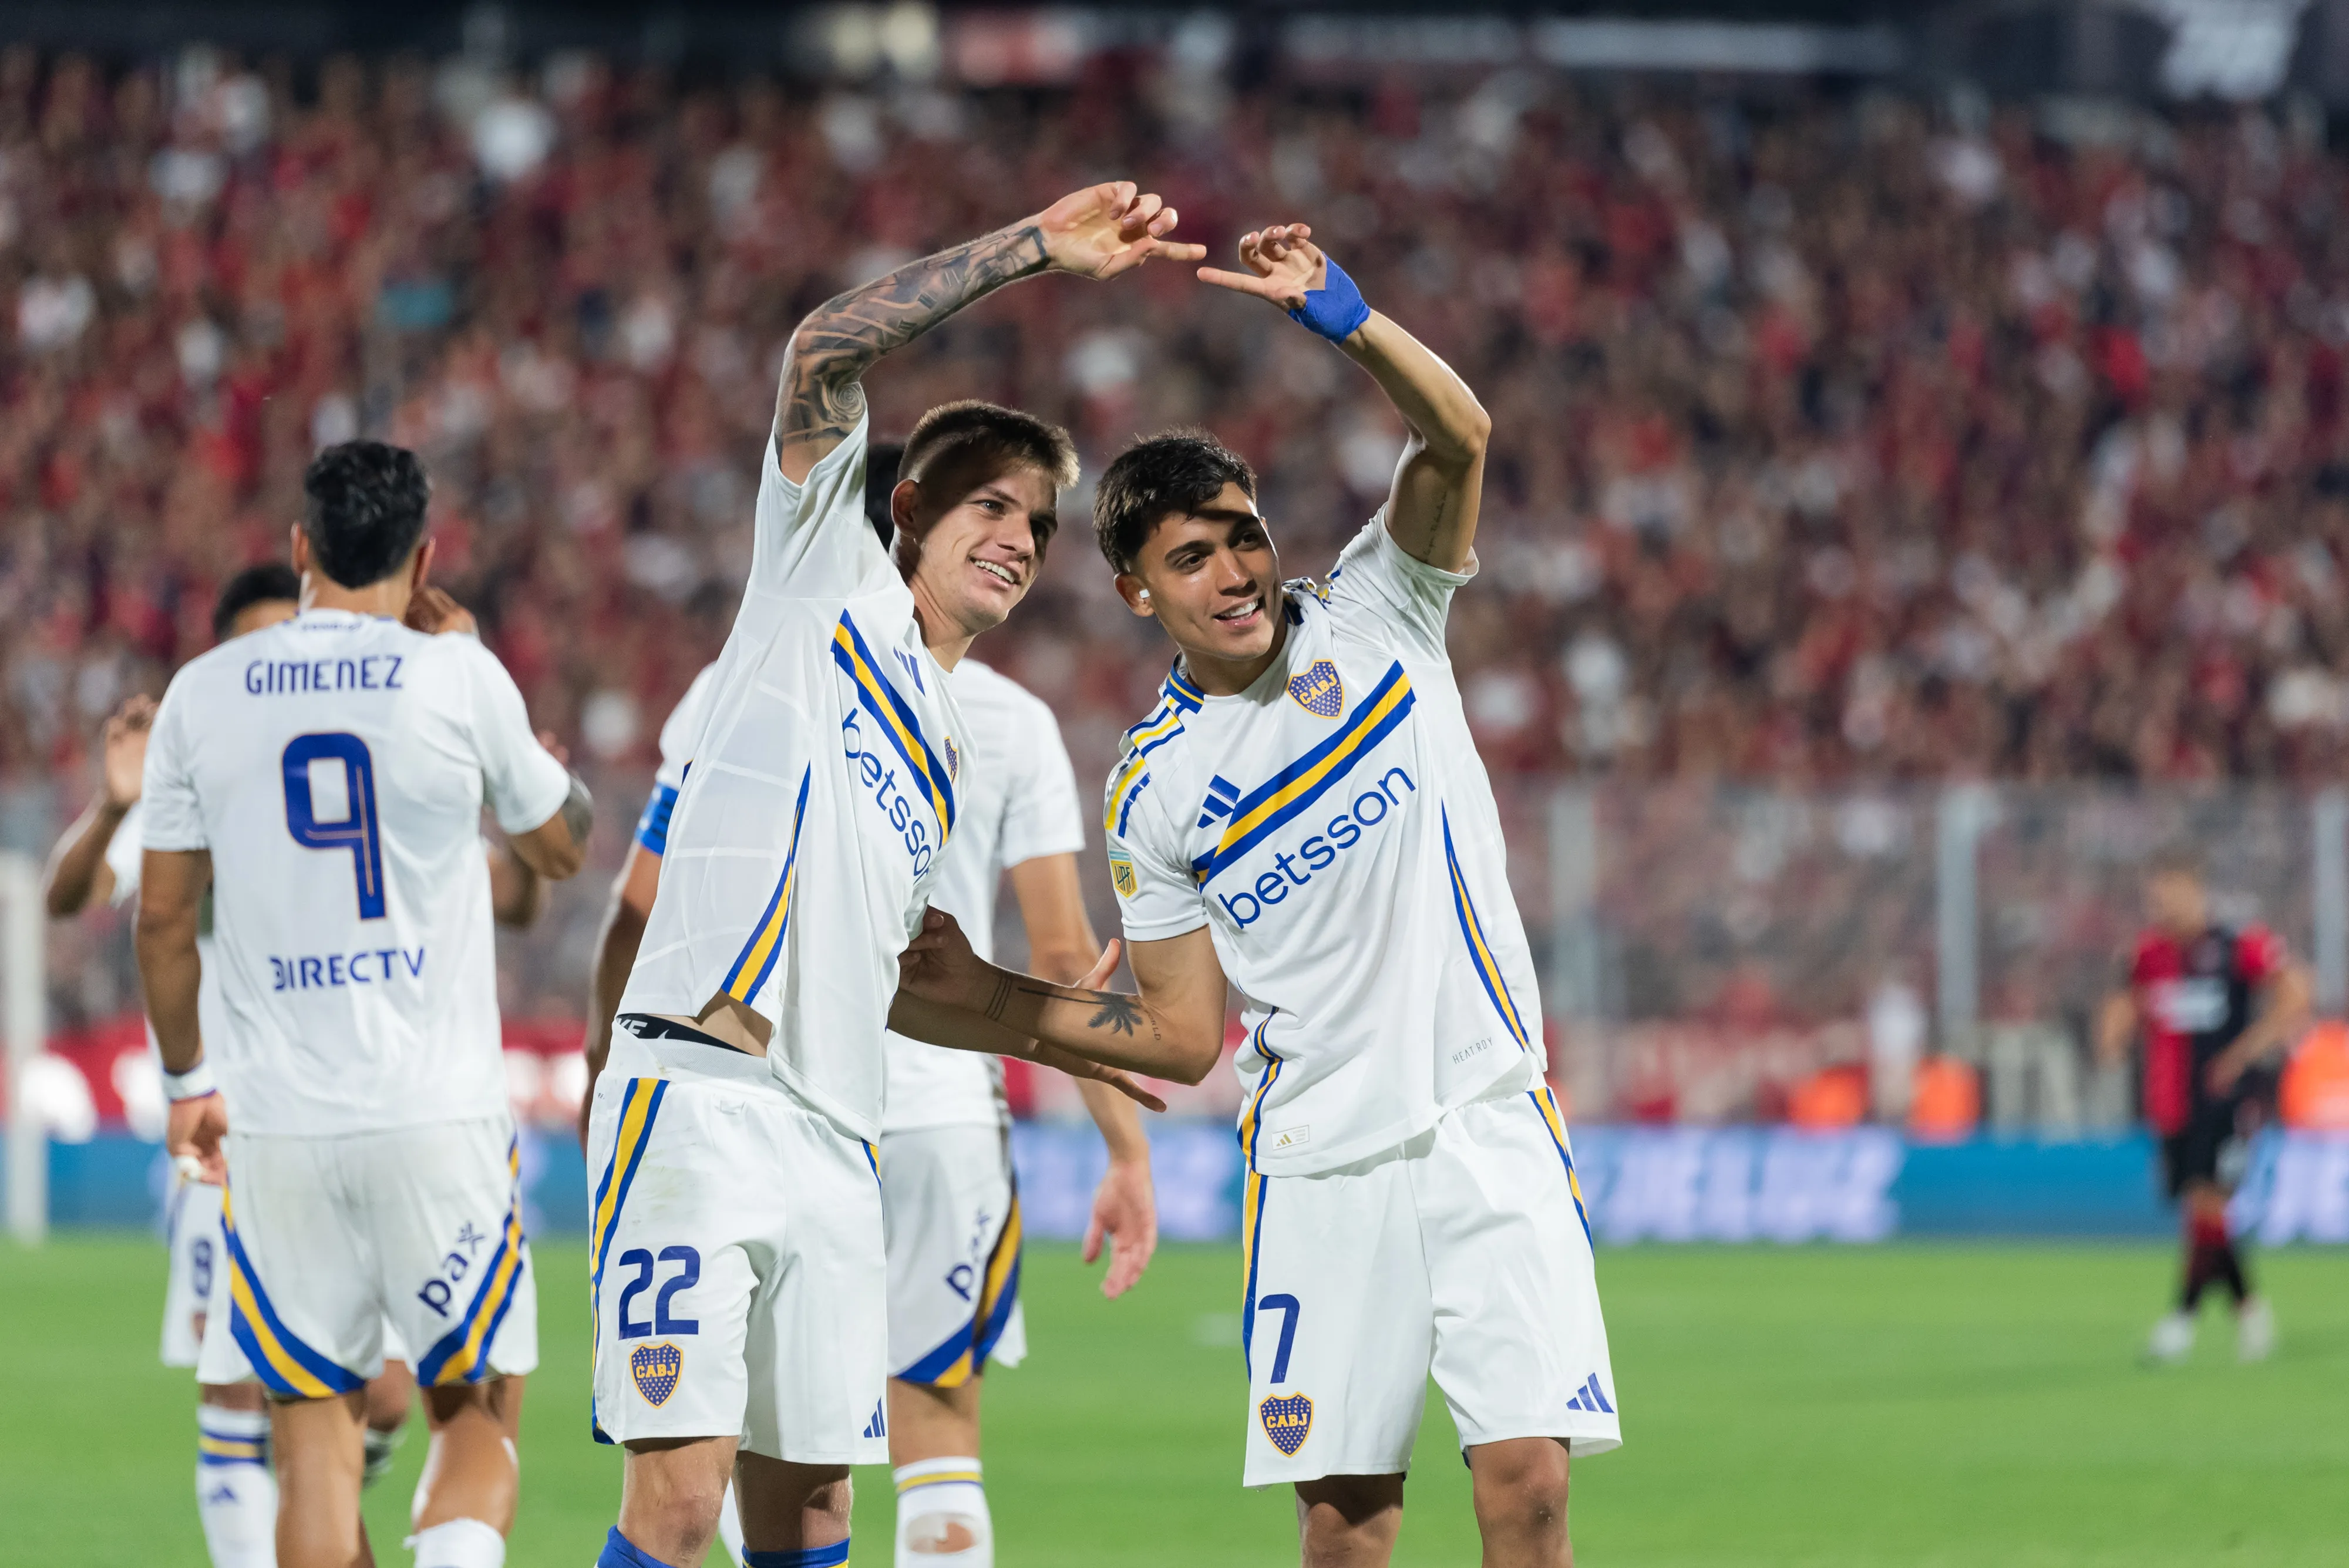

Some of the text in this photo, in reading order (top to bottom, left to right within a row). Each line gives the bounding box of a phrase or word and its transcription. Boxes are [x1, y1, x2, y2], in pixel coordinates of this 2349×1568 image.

[246, 655, 402, 694] GIMENEZ
[1300, 674, 1337, 704] CABJ
[282, 733, 386, 920] 9
[1217, 767, 1416, 929] betsson
[270, 947, 423, 991] DIRECTV
[1452, 1036, 1492, 1064] HEAT.RDY
[418, 1222, 485, 1317] pax
[618, 1246, 701, 1341] 22
[1258, 1293, 1300, 1384] 7
[636, 1363, 677, 1379] CABJ
[1266, 1413, 1307, 1428] CABJ
